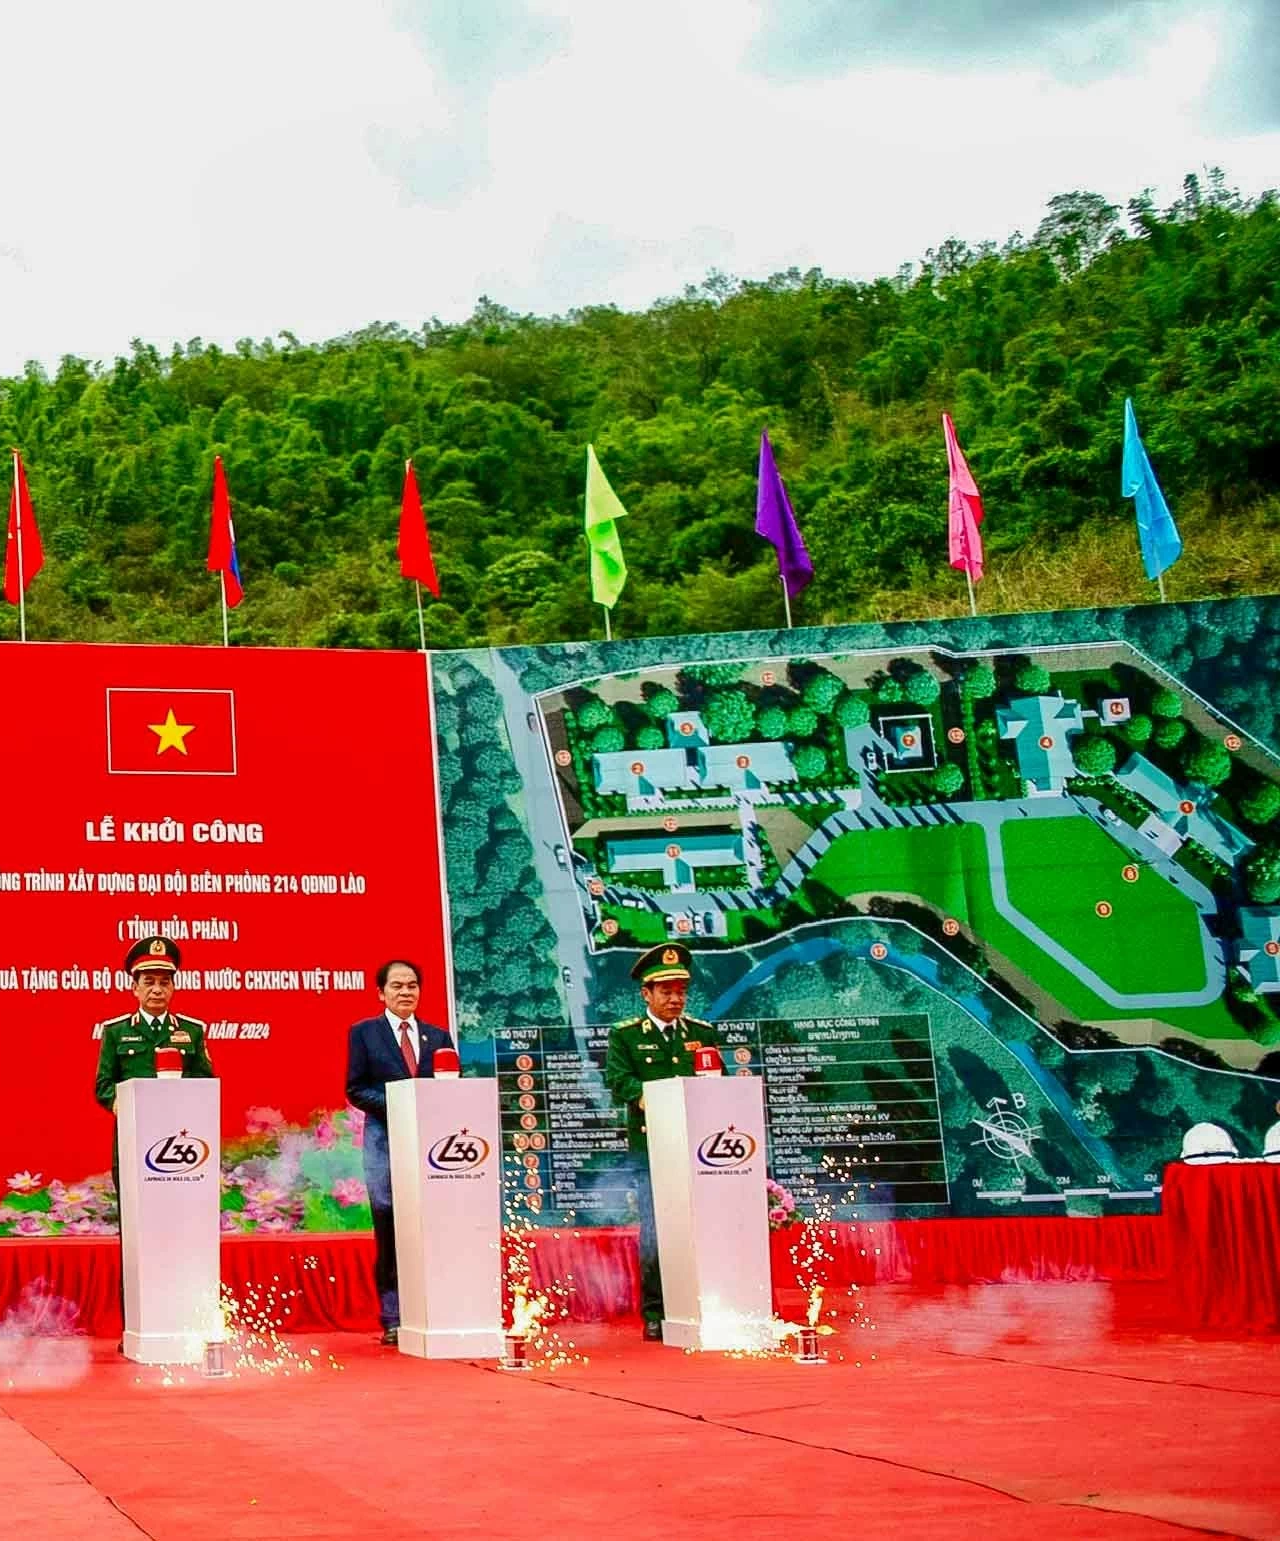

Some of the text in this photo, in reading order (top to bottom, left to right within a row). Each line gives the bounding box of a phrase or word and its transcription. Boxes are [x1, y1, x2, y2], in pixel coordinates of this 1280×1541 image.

[87, 816, 263, 842] LỄ KHỞI CÔNG
[24, 868, 64, 891] TRÌNH
[68, 868, 94, 891] XÂY
[98, 872, 135, 895] DỰNG
[138, 874, 161, 895] ĐẠI
[164, 869, 187, 896] ĐỘI
[191, 871, 222, 892] BIÊN
[225, 871, 270, 892] PHÒNG
[274, 876, 298, 892] 214
[301, 875, 337, 895] QĐND
[341, 872, 365, 893] LÀO
[126, 914, 158, 939] TỈNH
[22, 967, 58, 993] TẶNG
[62, 965, 89, 989] CỦA
[93, 967, 111, 993] BỘ
[205, 967, 241, 990] NƯỚC
[245, 971, 299, 989] CHXHCN
[302, 968, 330, 993] VIỆT
[334, 971, 364, 990] NAM
[207, 1020, 269, 1039] NĂM 2024
[1012, 1093, 1026, 1109] B
